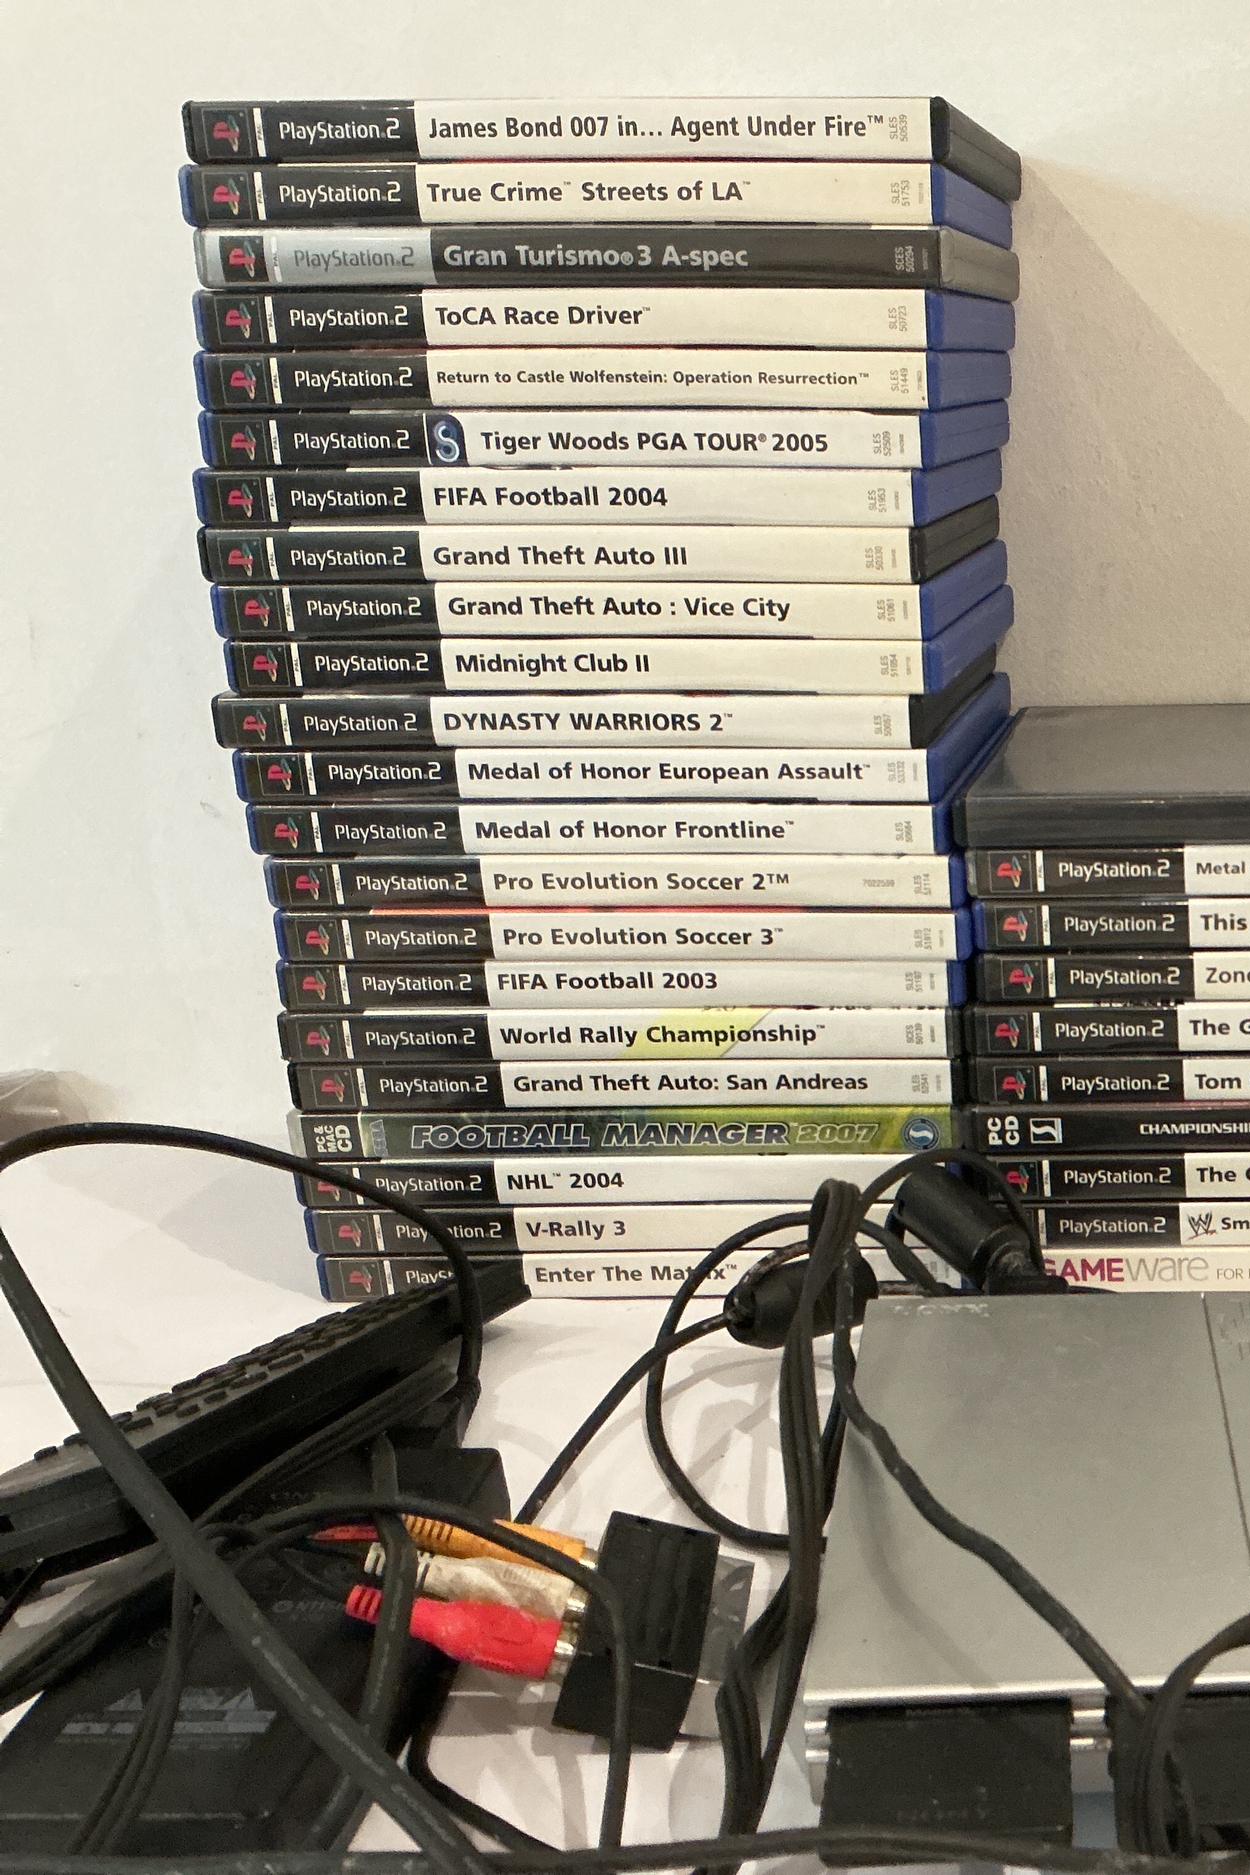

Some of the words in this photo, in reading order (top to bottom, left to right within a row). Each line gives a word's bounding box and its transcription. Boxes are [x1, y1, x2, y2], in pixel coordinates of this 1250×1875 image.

[429, 119, 497, 138] James
[506, 116, 562, 137] Bond
[571, 117, 608, 137] 007
[671, 116, 739, 142] Agent
[748, 115, 816, 136] Under
[889, 117, 898, 139] SLES
[427, 184, 481, 202] True
[582, 182, 668, 201] Streets
[677, 181, 702, 200] of
[891, 183, 900, 203] SLES
[444, 245, 506, 265] Gran
[662, 245, 748, 270] A-spec
[435, 307, 496, 325] ToCA
[504, 307, 559, 324] Race
[437, 372, 489, 383] Return
[495, 372, 511, 383] to
[517, 370, 564, 383] Castle
[570, 370, 667, 383] Wolfenstein:
[673, 371, 752, 386] Operation
[481, 431, 541, 455] Tiger
[548, 431, 629, 450] Woods
[638, 433, 687, 450] PGA
[772, 434, 827, 452] 2005
[434, 488, 487, 505] FIFA
[496, 486, 598, 505] Football
[609, 487, 667, 506] 2004
[434, 546, 510, 565] Grand
[518, 545, 585, 564] Theft
[595, 547, 655, 565] Auto
[665, 547, 687, 565] III
[449, 596, 522, 615] Grand
[530, 596, 594, 615] Theft
[603, 597, 661, 615] Auto
[684, 597, 734, 616] Vice
[743, 598, 790, 621] City
[456, 654, 567, 677] Midnight
[574, 654, 627, 672] Club
[636, 655, 649, 672] II
[444, 713, 560, 730] DYNASTY
[570, 713, 700, 731] WARRIORS
[469, 762, 539, 780] Medal
[549, 762, 572, 779] of
[581, 763, 651, 779] Honor
[660, 763, 768, 783] European
[476, 821, 550, 838] Medal
[560, 820, 584, 838] of
[594, 822, 666, 838] Honor
[1197, 862, 1245, 874] Metal
[494, 874, 533, 889] Pro
[542, 872, 658, 889] Evolution
[667, 873, 743, 890] Soccer
[1201, 914, 1247, 930] This
[504, 929, 542, 945] Pro
[551, 928, 666, 944] Evolution
[676, 929, 752, 945] Soccer
[498, 974, 547, 990] FIFA
[556, 972, 653, 989] Football
[663, 973, 717, 989] 2003
[500, 1027, 571, 1044] World
[580, 1026, 637, 1047] Rally
[1189, 1019, 1230, 1035] The
[514, 1075, 583, 1092] Grand
[590, 1074, 650, 1090] Theft
[658, 1075, 718, 1090] Auto:
[727, 1075, 767, 1090] San
[776, 1074, 868, 1089] Andreas
[1195, 1074, 1241, 1089] Tom
[324, 1125, 337, 1152] MAC
[335, 1125, 352, 1152] CD
[411, 1124, 590, 1148] FOOTBALL
[796, 1122, 880, 1144] 2007
[988, 1118, 1002, 1145] PC
[1005, 1116, 1019, 1145] CD
[570, 1173, 624, 1188] 2004
[1196, 1167, 1236, 1182] The
[526, 1220, 604, 1240] V-Rally
[614, 1221, 625, 1235] 3
[535, 1268, 595, 1282] Enter
[602, 1266, 642, 1281] The
[1217, 1269, 1243, 1279] FOR
